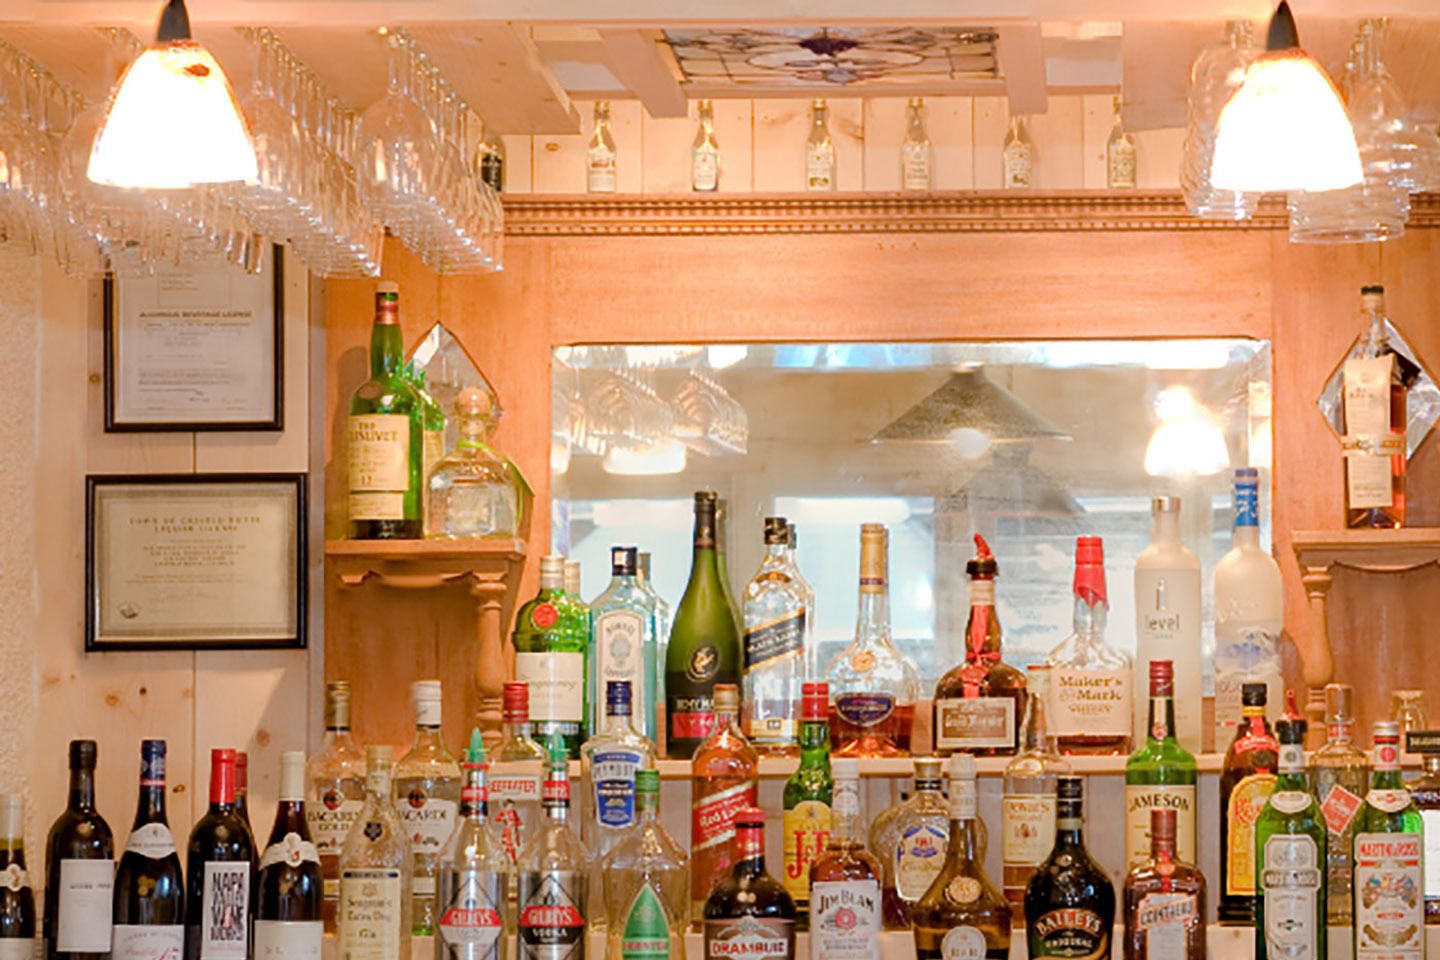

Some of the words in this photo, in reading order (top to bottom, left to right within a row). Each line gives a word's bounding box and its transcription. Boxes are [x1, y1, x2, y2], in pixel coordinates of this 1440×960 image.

[1146, 614, 1180, 630] level
[1058, 675, 1122, 688] Maker's
[1077, 688, 1122, 701] Mark
[1128, 793, 1190, 813] JAMESON
[818, 893, 841, 915] JIM
[840, 889, 875, 912] BEAM
[1035, 911, 1102, 935] BAILEYS
[711, 940, 786, 955] DRAMBUIE
